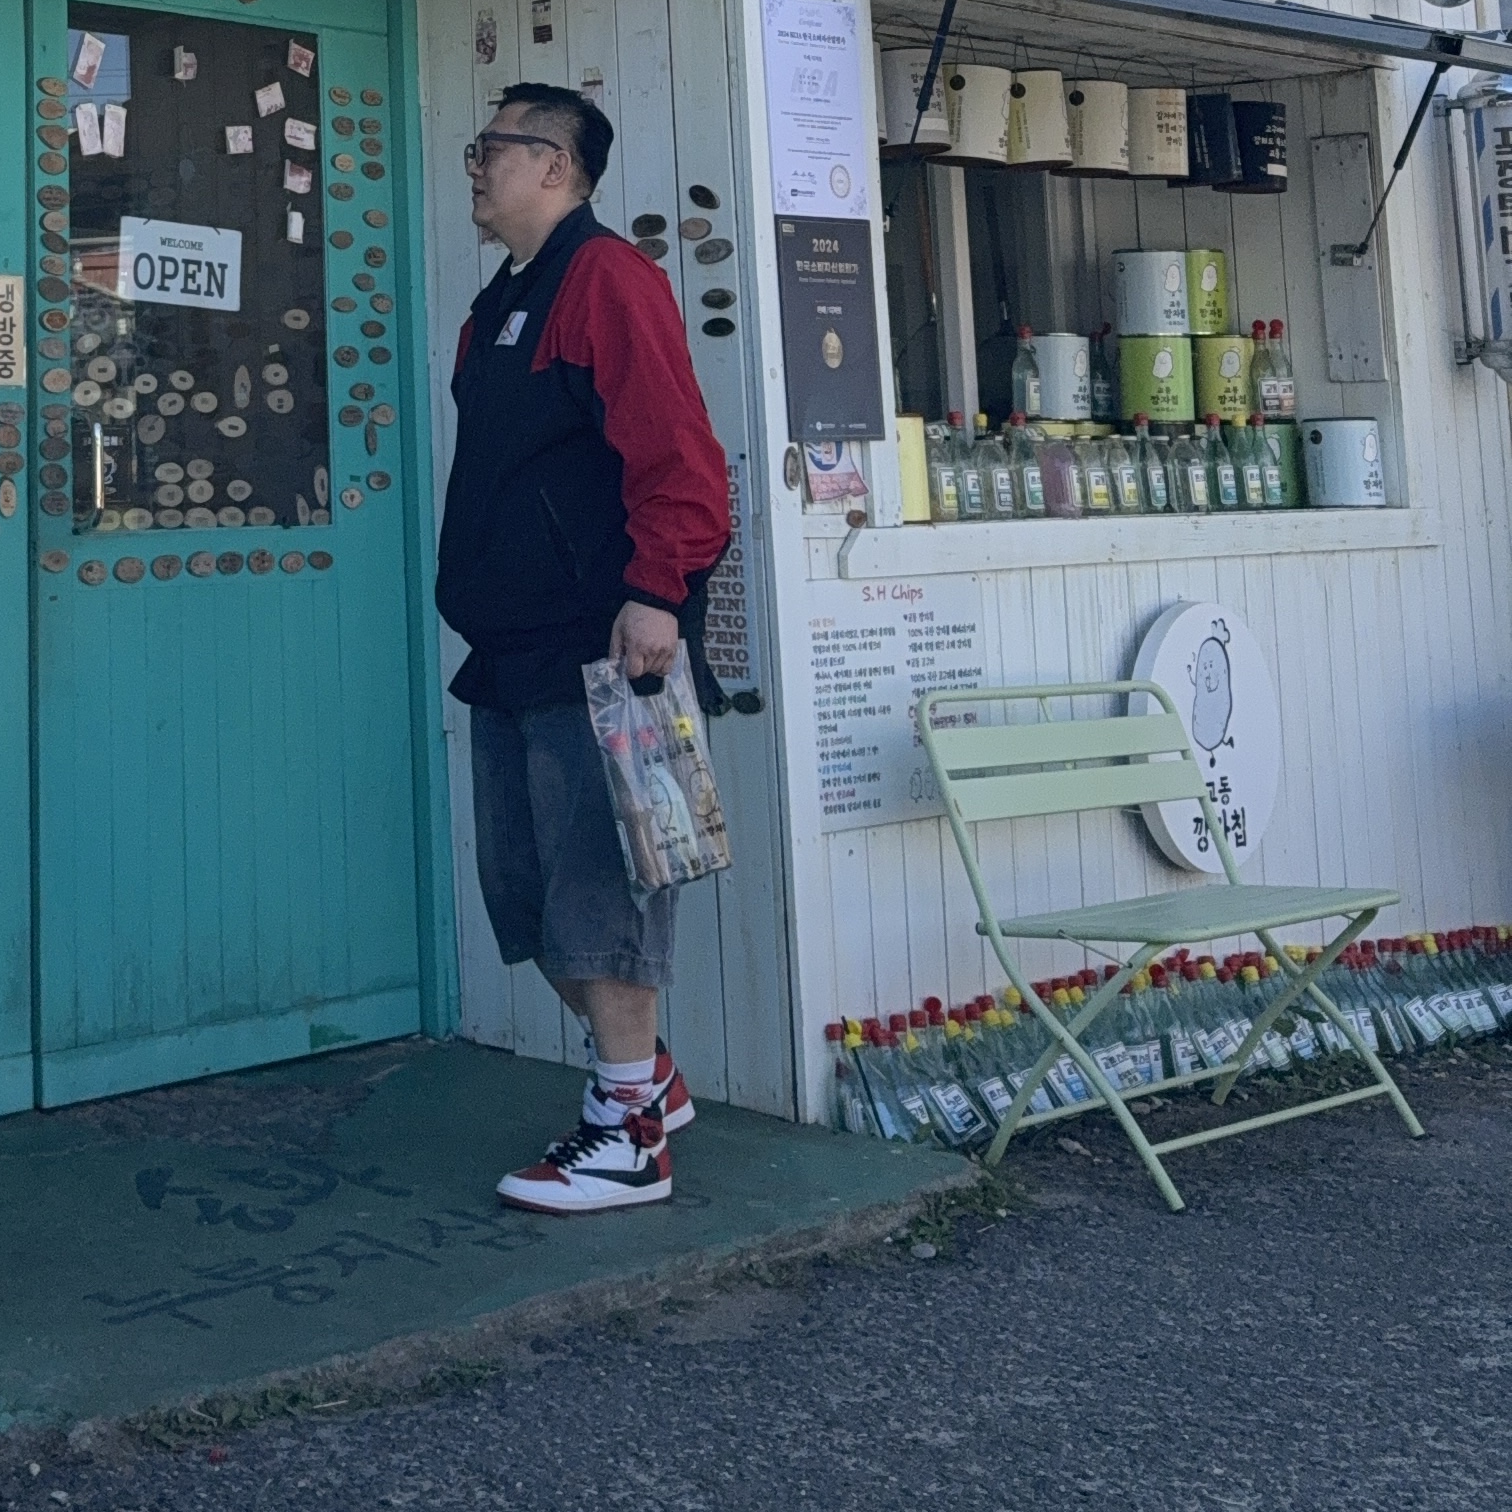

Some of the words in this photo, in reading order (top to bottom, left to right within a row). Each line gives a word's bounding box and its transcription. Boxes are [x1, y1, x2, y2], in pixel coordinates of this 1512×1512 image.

[160, 237, 203, 251] WELCOME
[811, 238, 839, 253] 2024
[133, 252, 228, 299] OPEN
[891, 583, 924, 604] Chips
